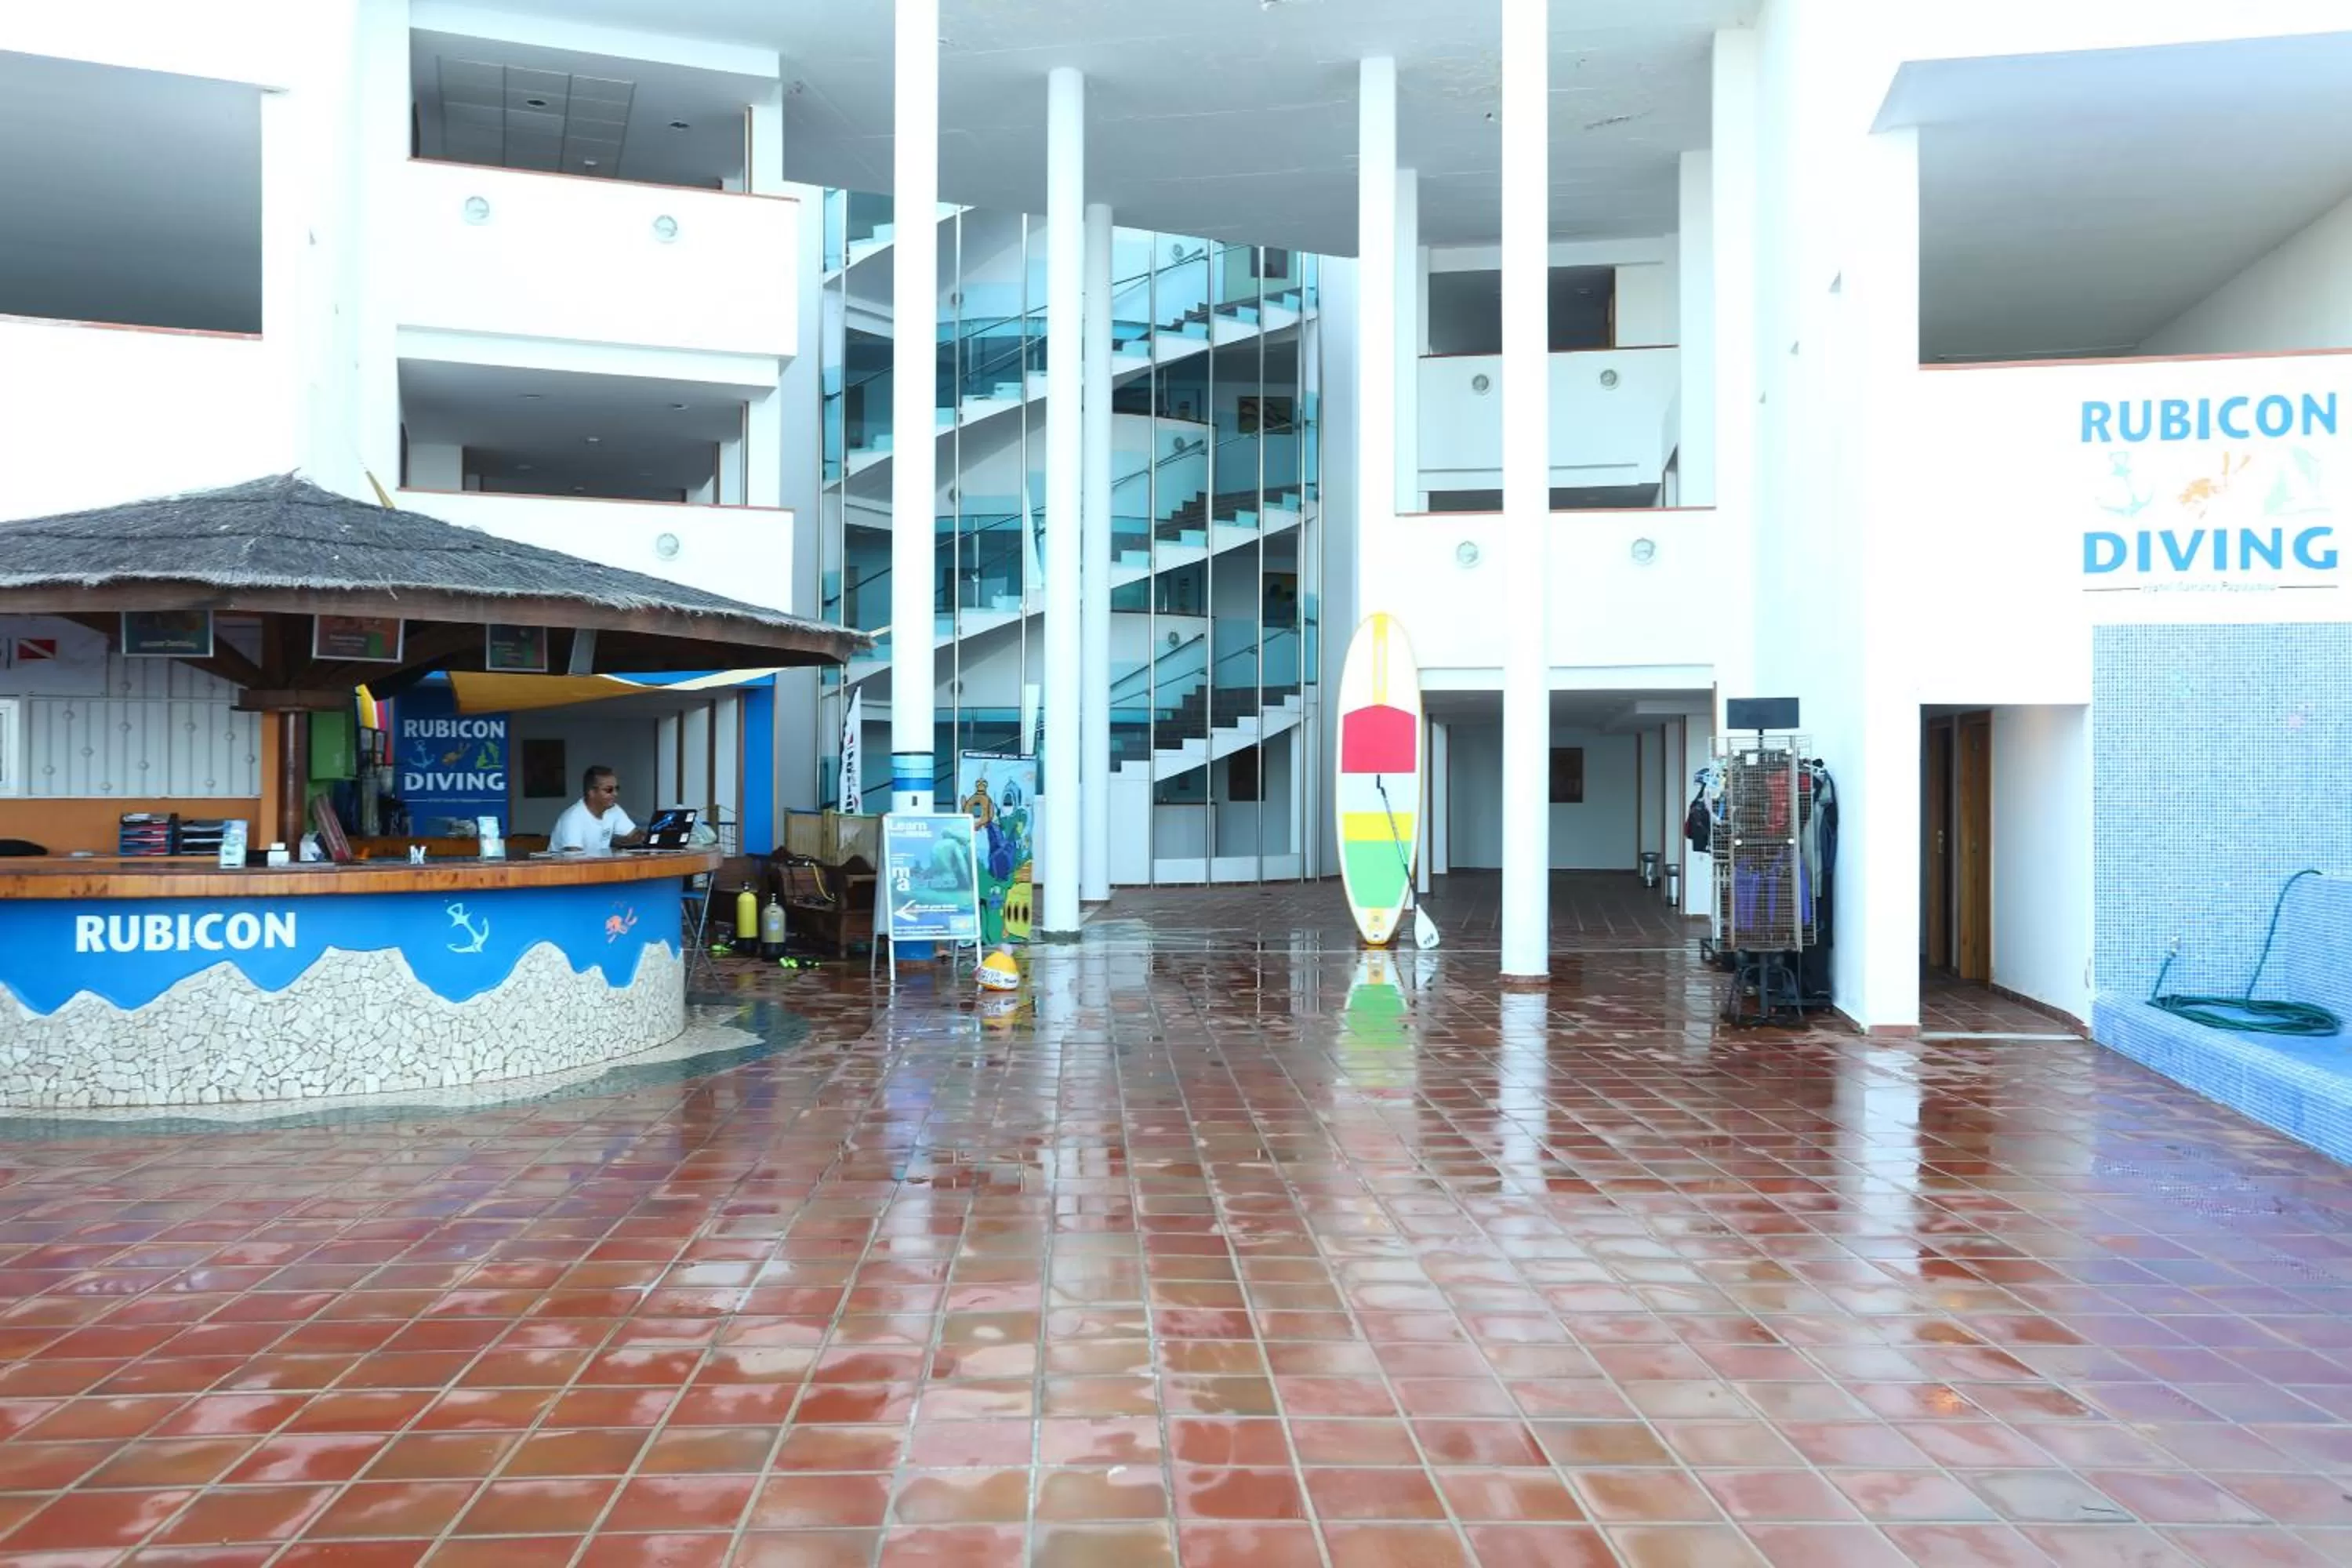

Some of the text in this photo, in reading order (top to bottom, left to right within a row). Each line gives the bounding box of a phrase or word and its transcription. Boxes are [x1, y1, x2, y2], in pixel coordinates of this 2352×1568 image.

[2081, 392, 2337, 443] RUBICON
[2083, 526, 2339, 574] DIVING
[404, 719, 506, 739] RUBICON
[404, 772, 506, 791] DIVING
[75, 912, 296, 953] RUBICON
